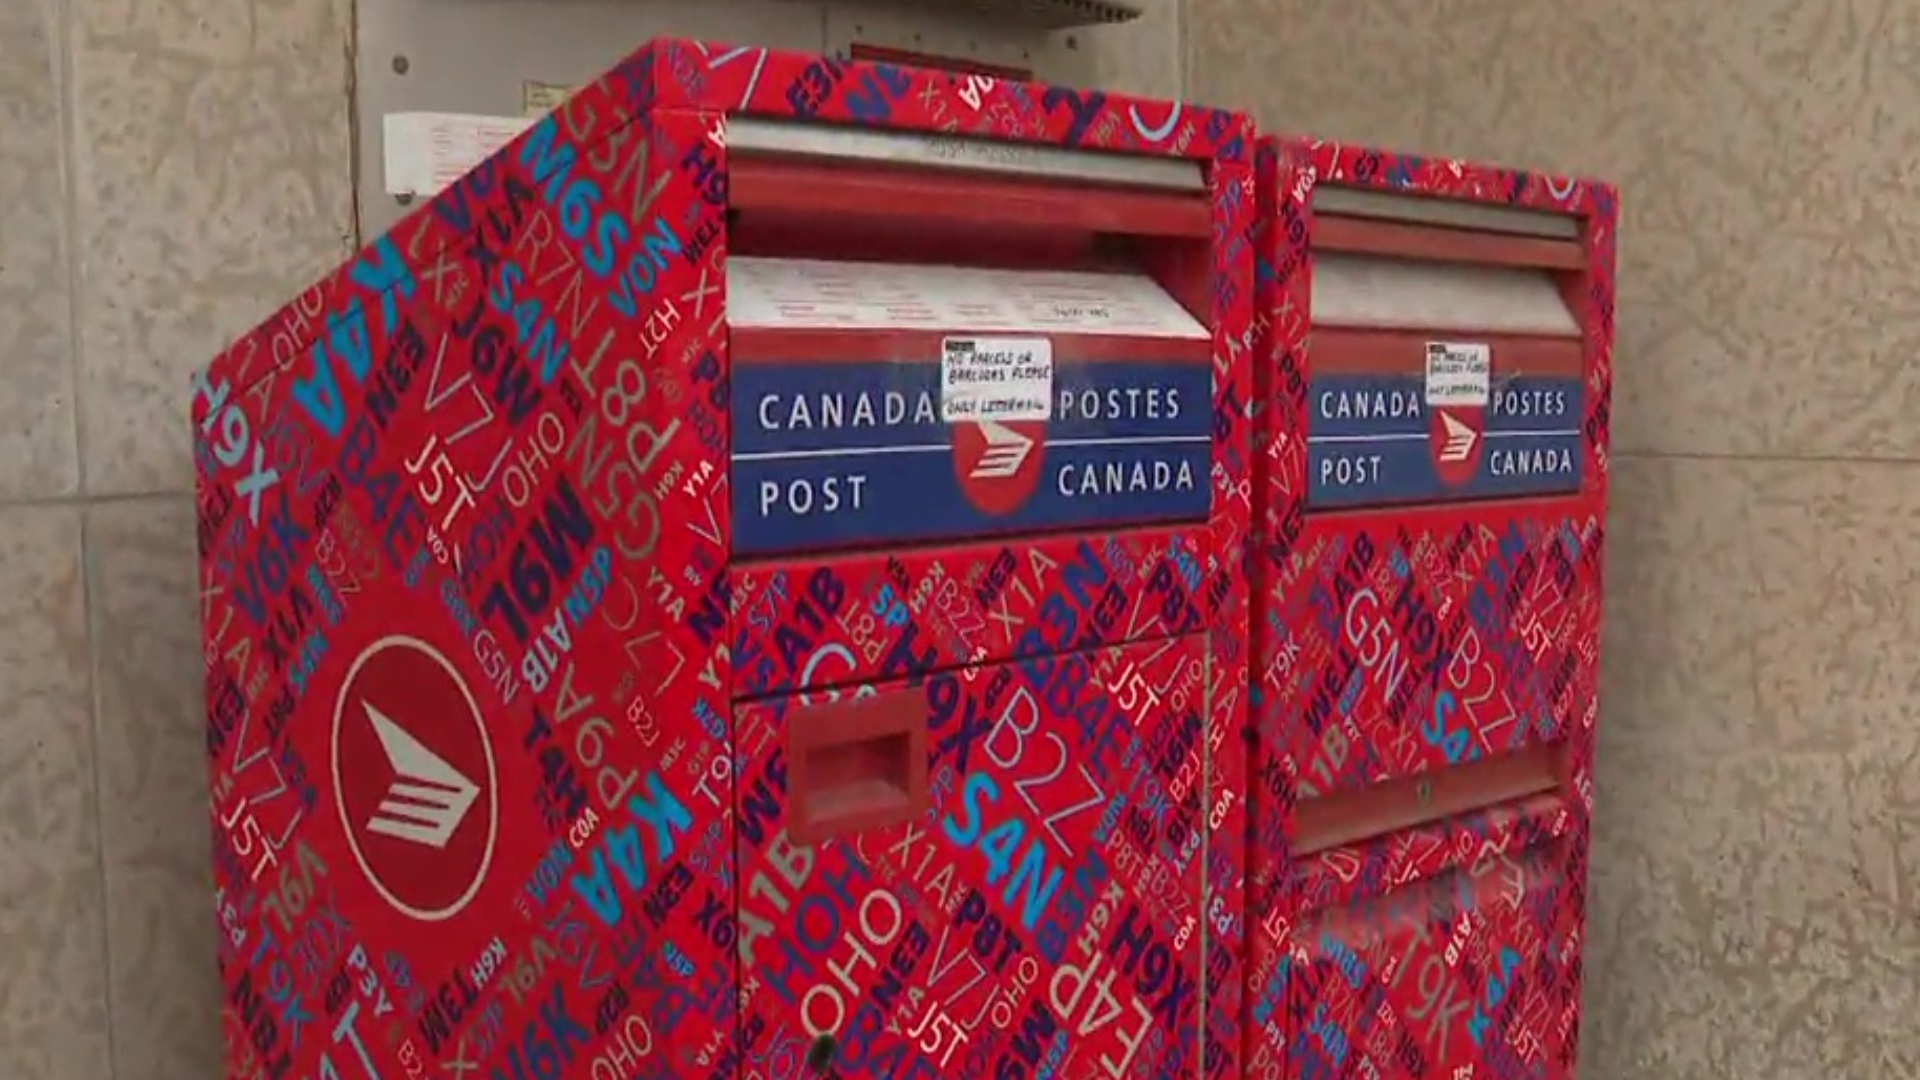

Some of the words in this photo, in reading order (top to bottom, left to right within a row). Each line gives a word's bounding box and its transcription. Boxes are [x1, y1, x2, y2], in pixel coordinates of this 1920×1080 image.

[518, 115, 629, 277] M6S
[516, 210, 600, 340] R7N
[289, 233, 416, 438] K4A
[452, 297, 542, 426] J6W
[488, 261, 569, 385] S4N
[638, 297, 682, 360] H2T
[570, 328, 682, 473] P8T
[760, 393, 934, 428] CANADA
[1061, 390, 1178, 419] POSTES
[1322, 392, 1418, 418] CANADA
[1494, 391, 1563, 414] POSTES
[403, 434, 475, 531] J5T
[564, 413, 661, 560] G5N
[683, 459, 714, 498] Y1A
[762, 477, 864, 515] POST
[1060, 461, 1191, 495] CANADA
[1322, 457, 1380, 484] POST
[1492, 450, 1571, 474] CANADA
[230, 490, 309, 624] V6K
[480, 474, 594, 640] M9L
[648, 566, 684, 623] Y1A
[988, 547, 1057, 643] X1A
[1146, 562, 1202, 635] P8T
[522, 607, 572, 693] A1B
[775, 566, 846, 676] A1B
[835, 603, 889, 665] P8T
[1015, 537, 1107, 692] B3N
[1345, 587, 1409, 704] G5N
[1520, 611, 1553, 663] J5T
[473, 628, 520, 704] G5N
[1107, 661, 1160, 727] J5T
[1264, 630, 1301, 691] T9K
[1447, 625, 1518, 754] B2Z
[553, 660, 638, 810] P9A
[1423, 690, 1481, 765] S4
[983, 685, 1105, 859] B2Z
[220, 797, 278, 882] J5T
[570, 769, 694, 927] K4A
[889, 822, 955, 910] X1A
[942, 772, 1064, 932] S4N
[738, 829, 816, 966] A1B
[953, 888, 1022, 973] P8T
[1035, 849, 1107, 965] B3N
[1077, 879, 1125, 956] K6H
[347, 943, 394, 1017] P3Y
[870, 920, 931, 1009] E3N
[1107, 904, 1195, 1030] H9X
[1390, 913, 1471, 1066] T9K
[907, 1001, 968, 1068] J5T
